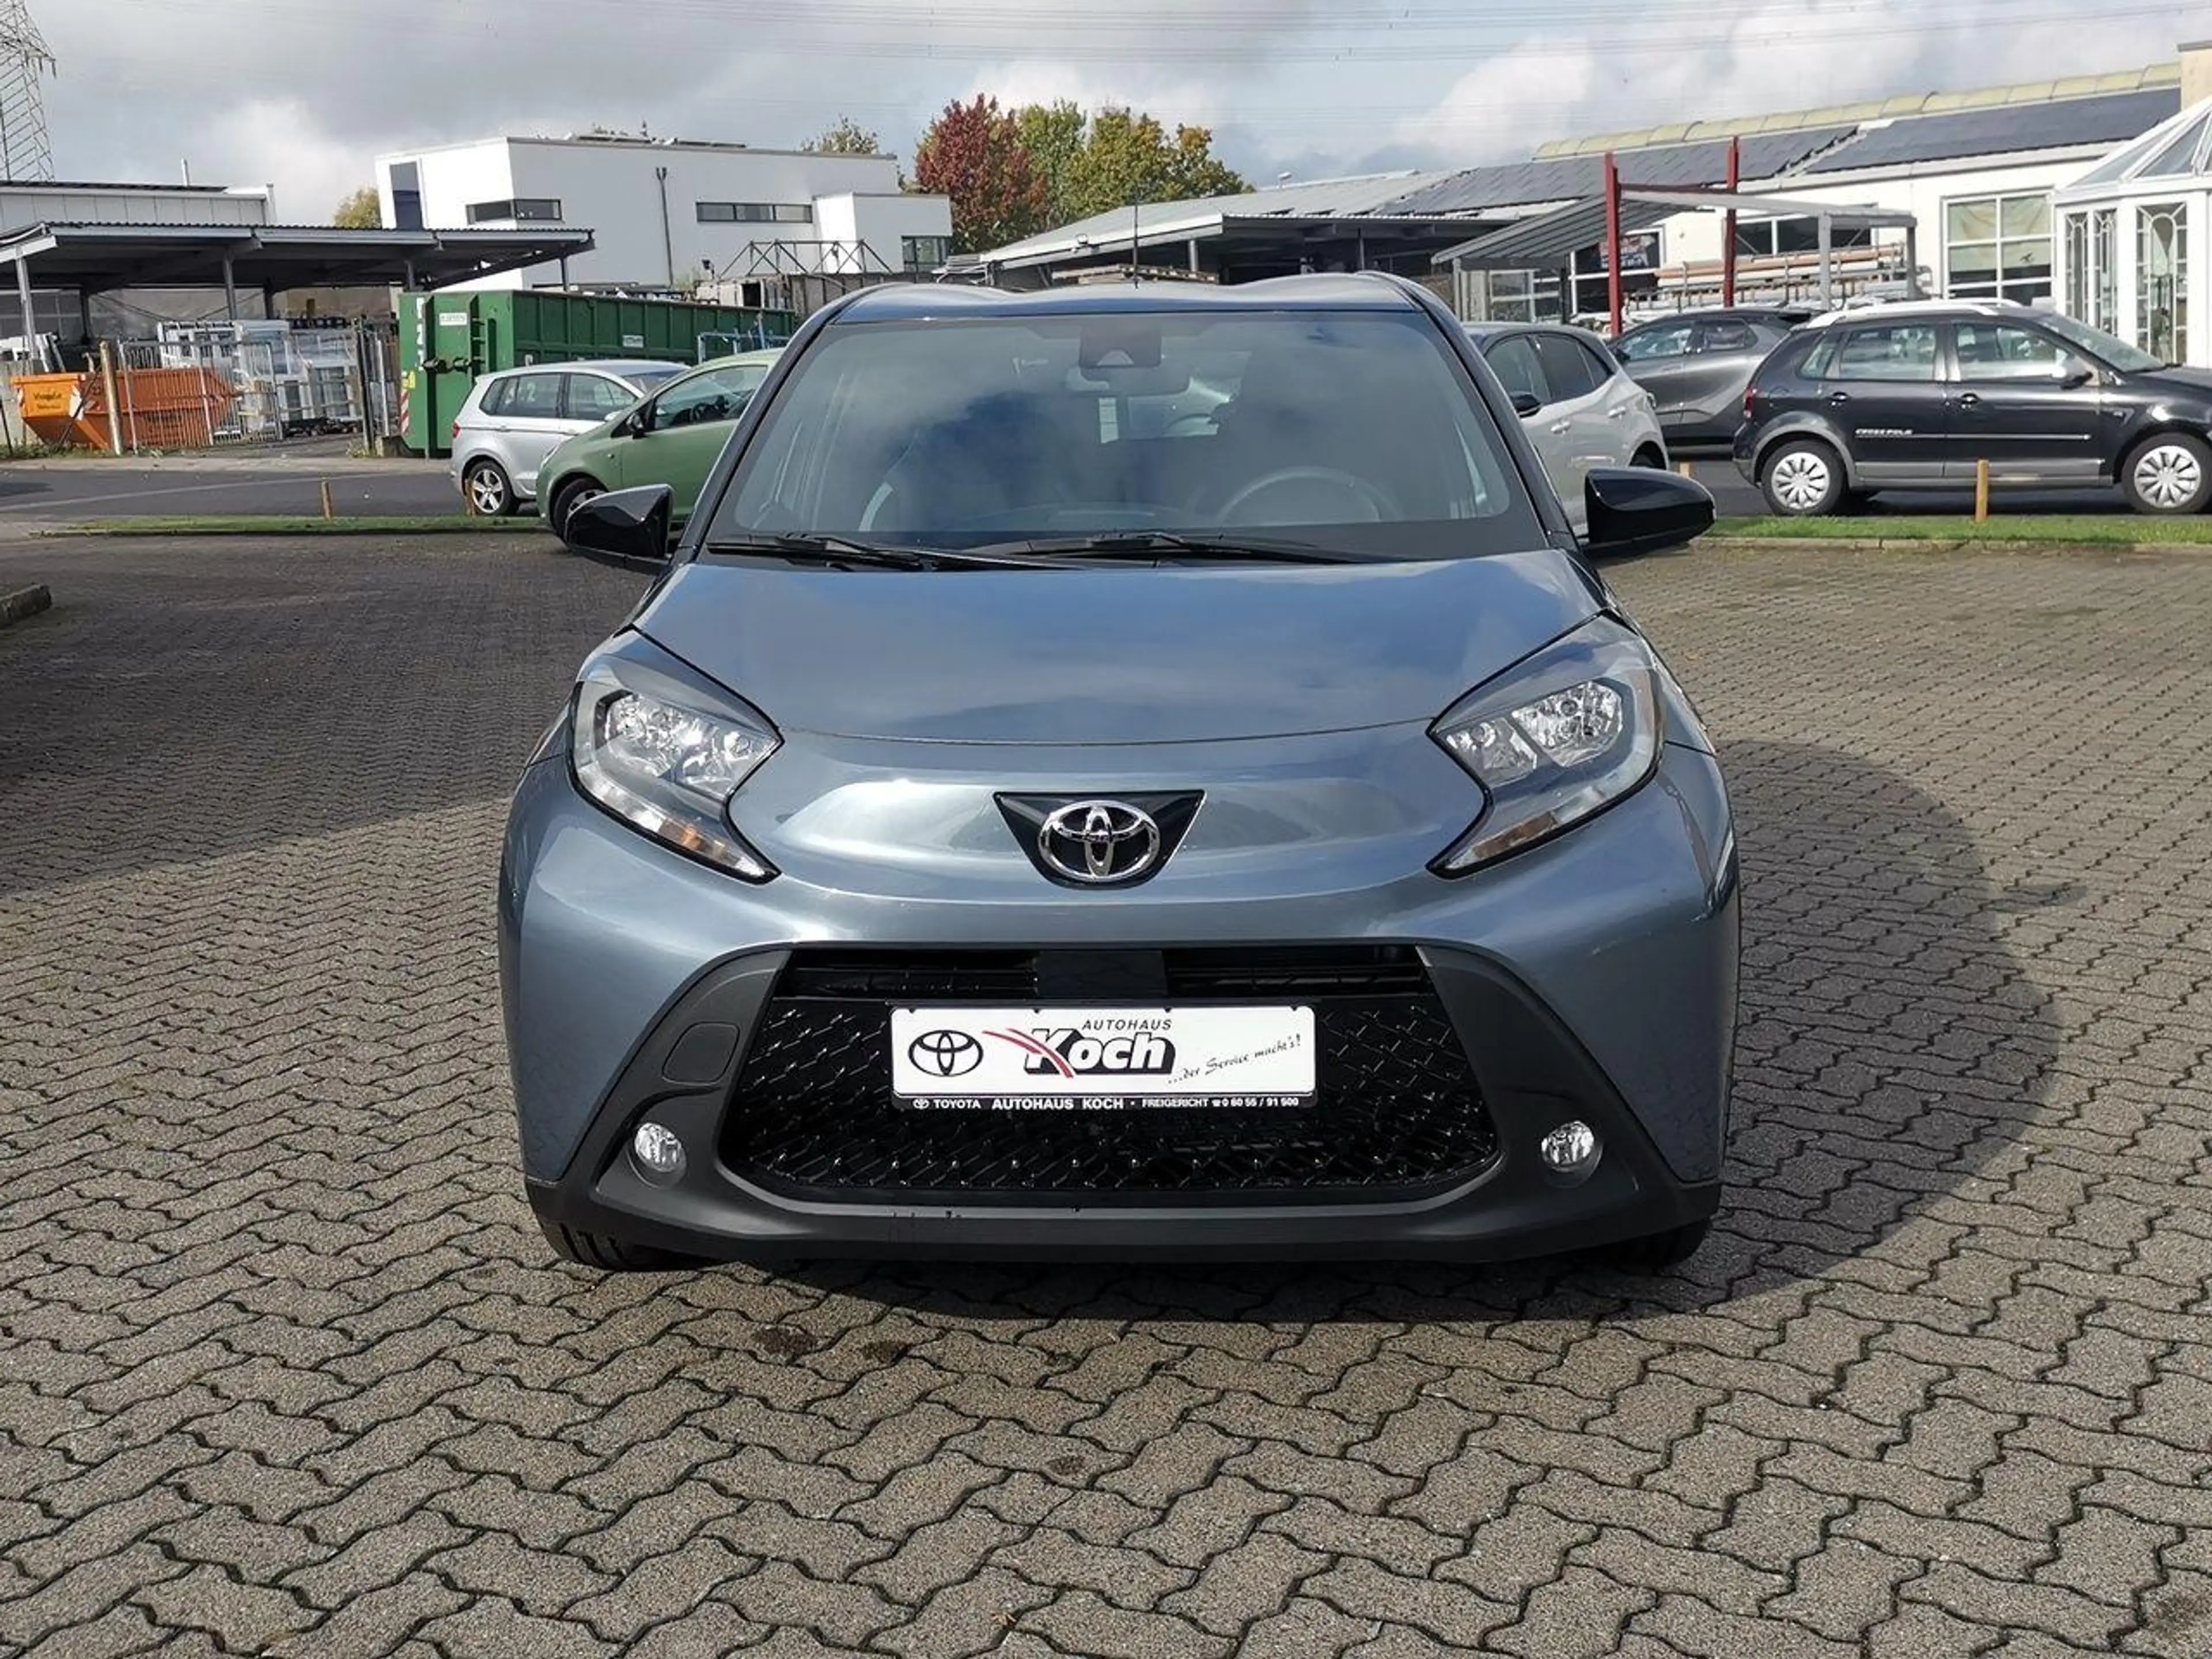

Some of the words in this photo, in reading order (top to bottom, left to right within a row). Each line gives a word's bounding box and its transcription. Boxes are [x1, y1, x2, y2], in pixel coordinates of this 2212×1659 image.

[1082, 1019, 1172, 1031] AUTOHAUS
[1024, 1028, 1176, 1075] Koch
[1205, 1057, 1249, 1075] Service
[933, 1099, 981, 1109] TOYOTA
[991, 1099, 1074, 1109] AUTOHAUS
[1082, 1099, 1123, 1109] KOCH
